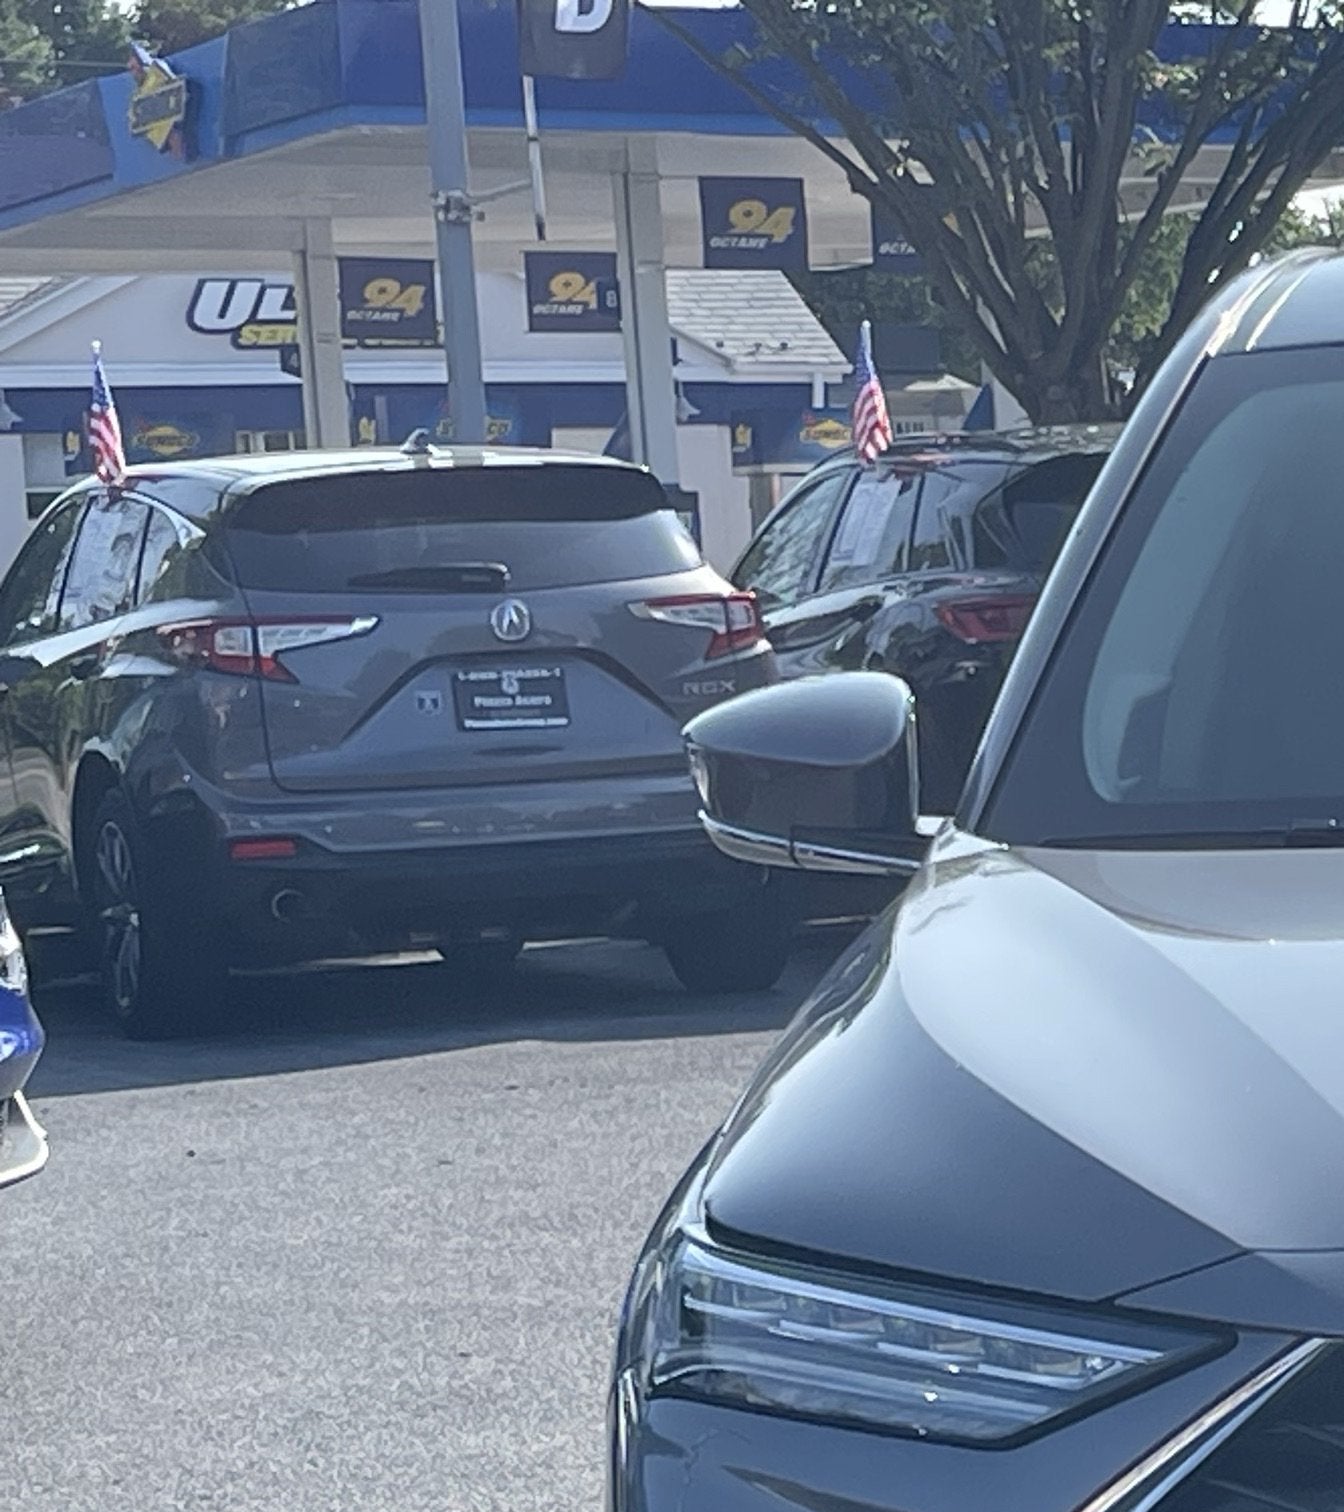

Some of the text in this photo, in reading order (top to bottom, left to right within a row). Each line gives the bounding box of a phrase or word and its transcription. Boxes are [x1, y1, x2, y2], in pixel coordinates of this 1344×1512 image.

[728, 199, 795, 243] 94
[709, 236, 769, 250] OCTANE
[878, 241, 917, 255] OCTA
[361, 278, 427, 317] 94
[347, 309, 402, 323] OCTANE
[532, 303, 584, 316] OCTANE
